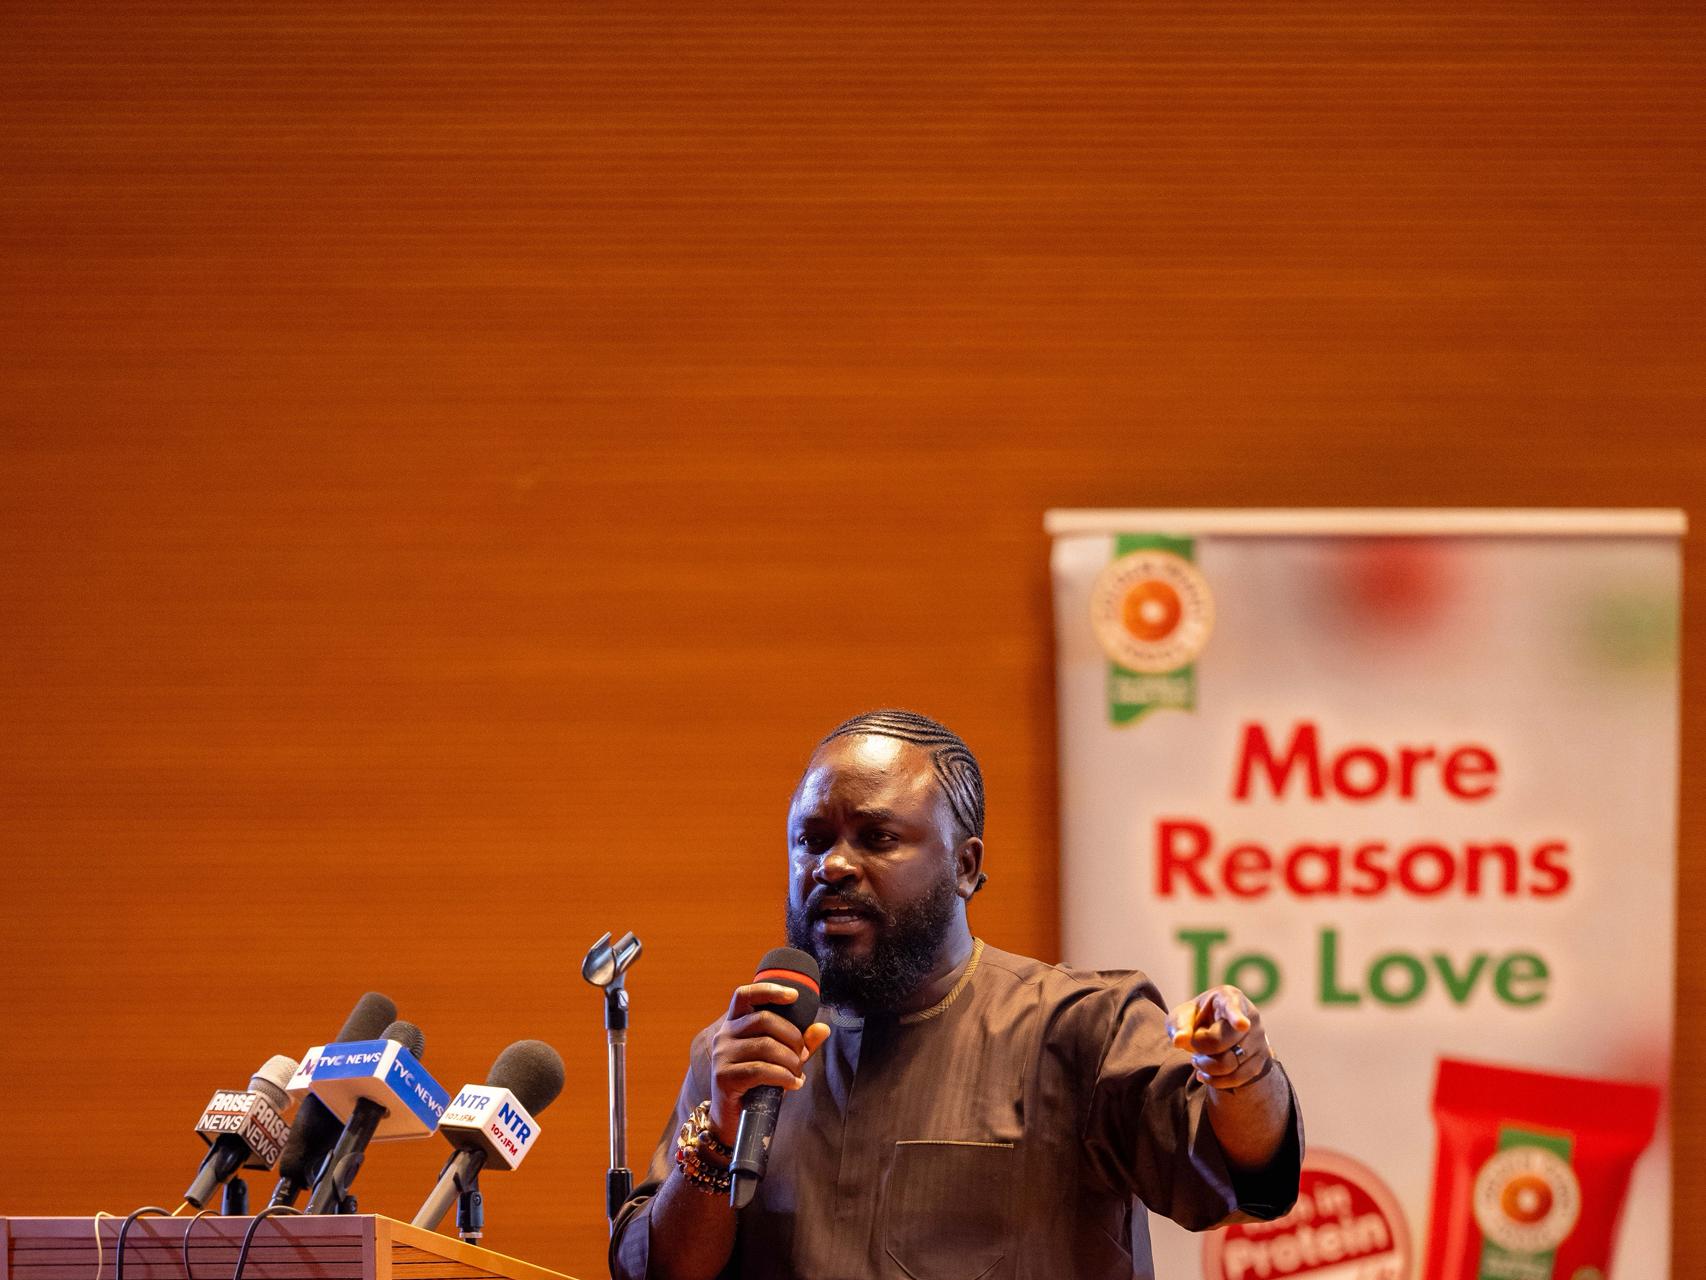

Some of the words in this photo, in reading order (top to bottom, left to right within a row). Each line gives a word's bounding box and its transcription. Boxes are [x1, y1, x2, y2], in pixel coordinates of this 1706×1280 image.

[1230, 721, 1499, 802] More
[1154, 819, 1571, 899] Reasons
[1175, 928, 1281, 1007] To
[1319, 928, 1550, 1007] Love
[319, 1055, 346, 1067] TVC
[346, 1051, 383, 1065] NEWS
[208, 1093, 257, 1112] ARISE
[393, 1058, 416, 1088] TVC
[414, 1083, 445, 1119] NEWS
[453, 1093, 491, 1111] NTR
[199, 1114, 244, 1130] NEWS
[244, 1121, 279, 1165] NEWS
[255, 1100, 291, 1146] ARISE
[490, 1123, 519, 1157] 107.1FM
[498, 1102, 531, 1145] NTR
